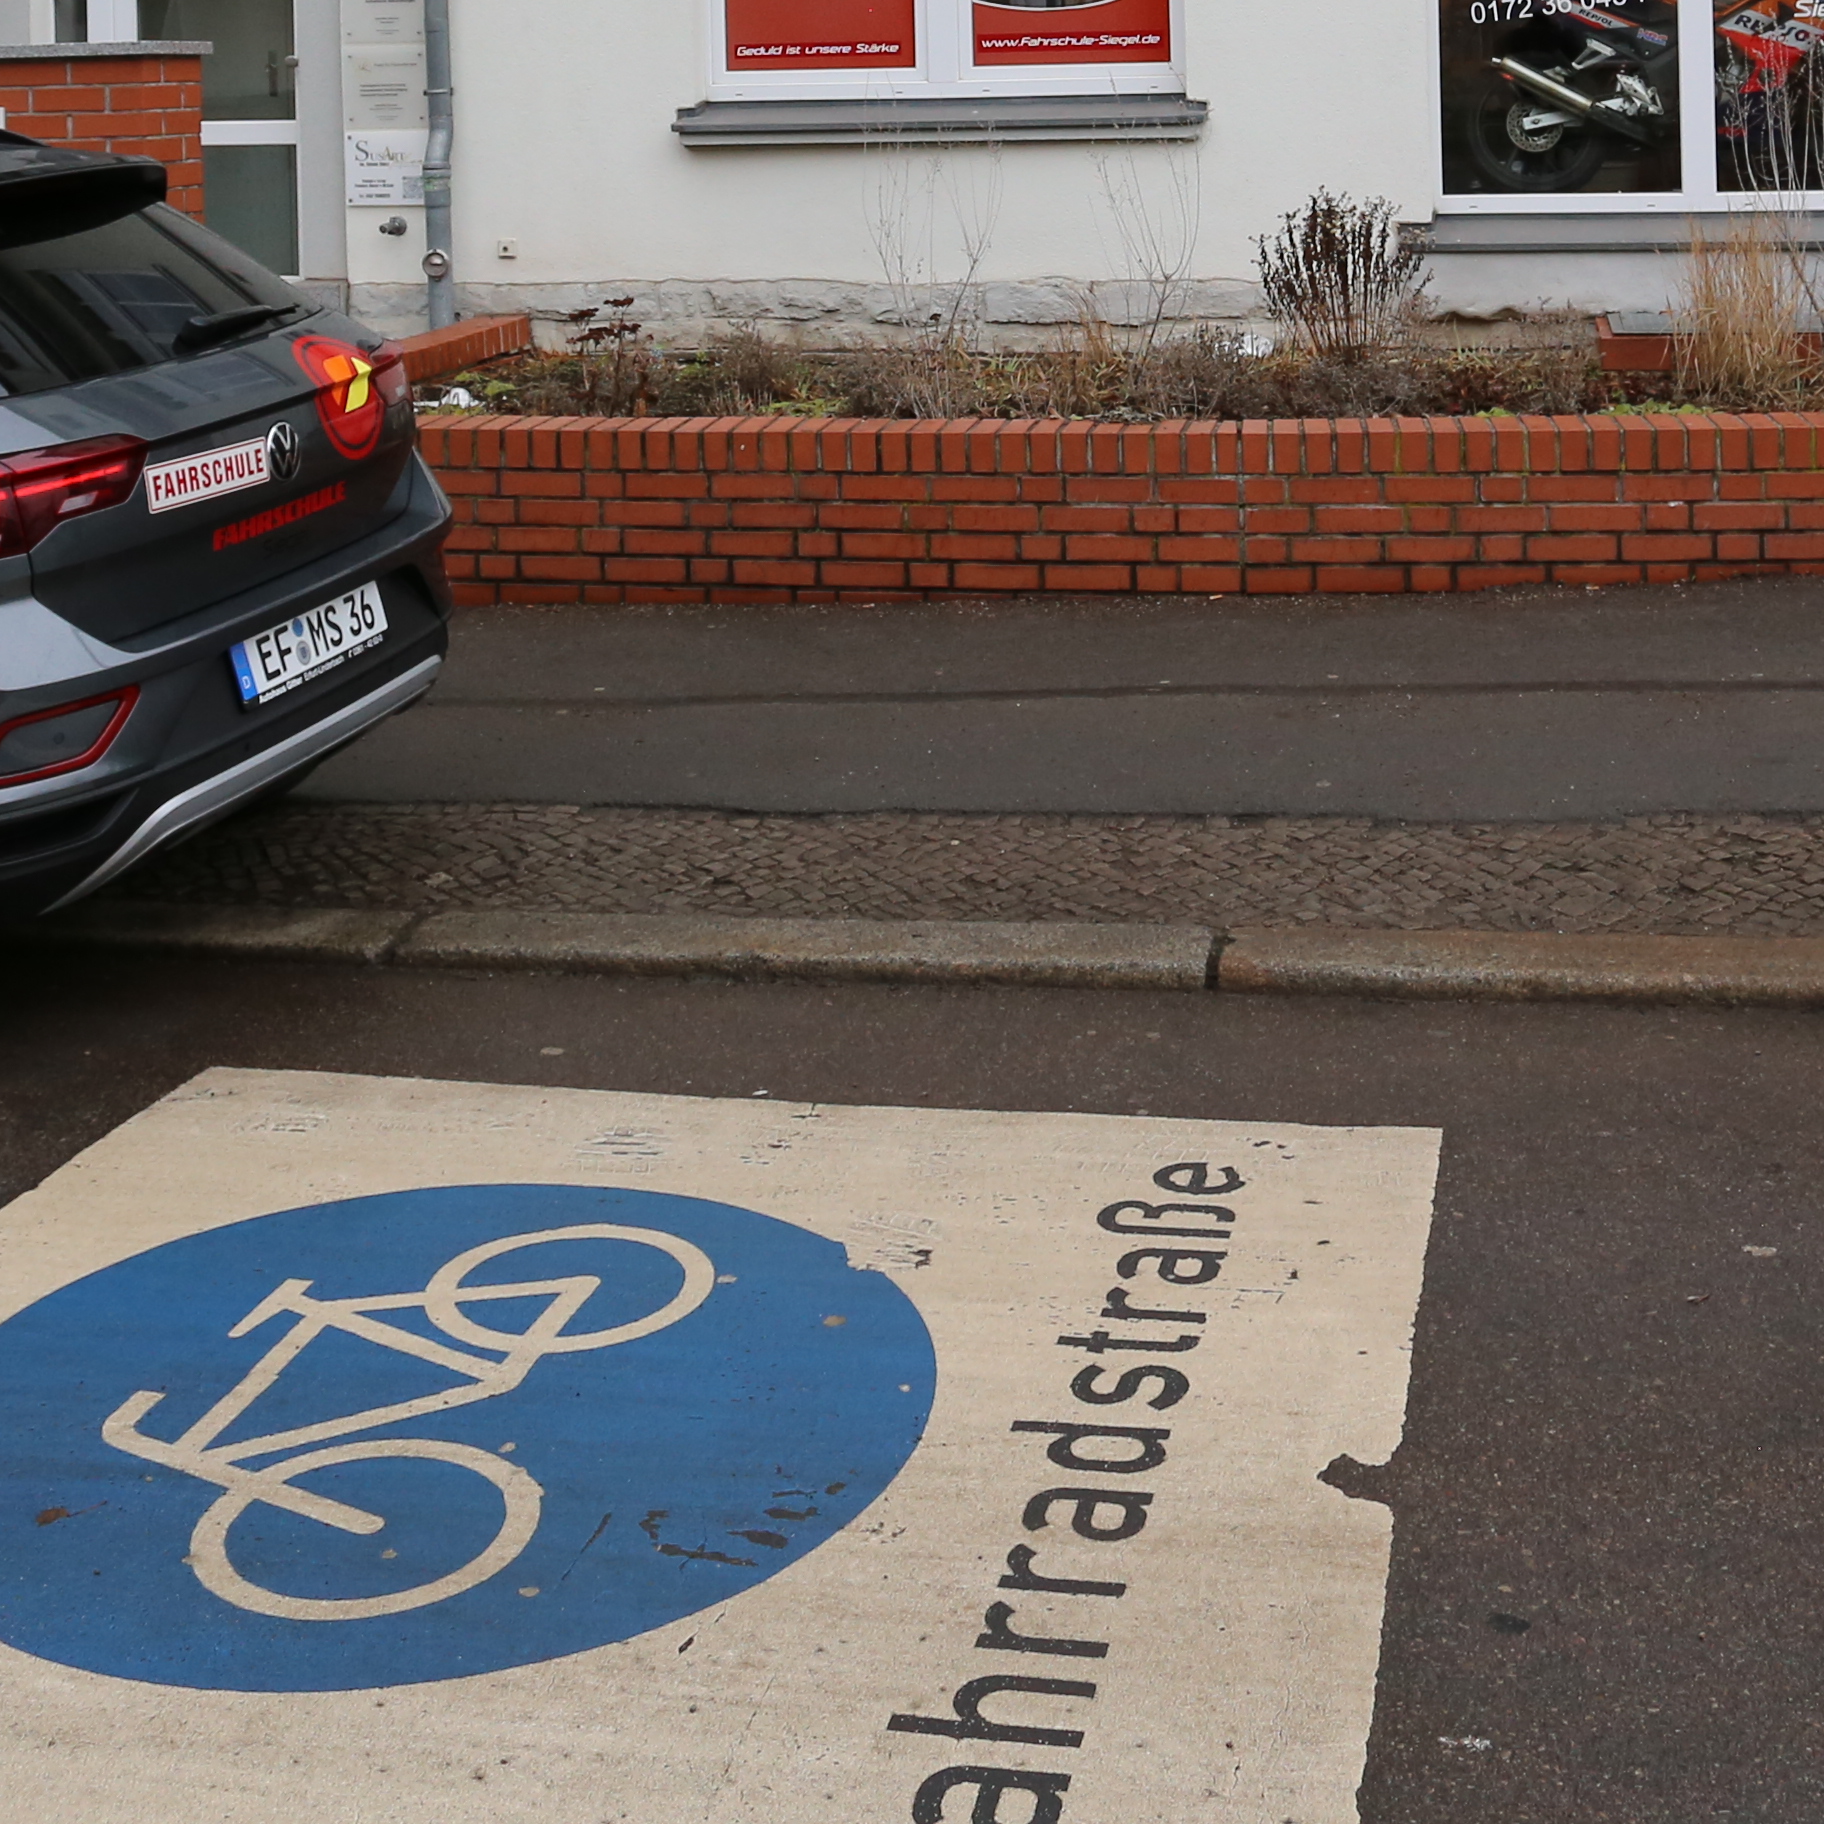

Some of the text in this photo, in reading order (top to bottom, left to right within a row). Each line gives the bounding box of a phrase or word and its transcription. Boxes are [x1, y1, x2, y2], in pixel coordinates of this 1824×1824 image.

[737, 42, 900, 57] Geduld ist unsere Stärke
[981, 34, 1161, 48] www.Fahrschule-Siegel.de
[152, 448, 265, 501] FAHRSCHULE
[213, 480, 347, 552] FAHRSCHULE
[255, 625, 292, 682] EF
[306, 605, 343, 657] MS
[343, 589, 375, 636] 36
[887, 1162, 1246, 1824] ahrradstraße
